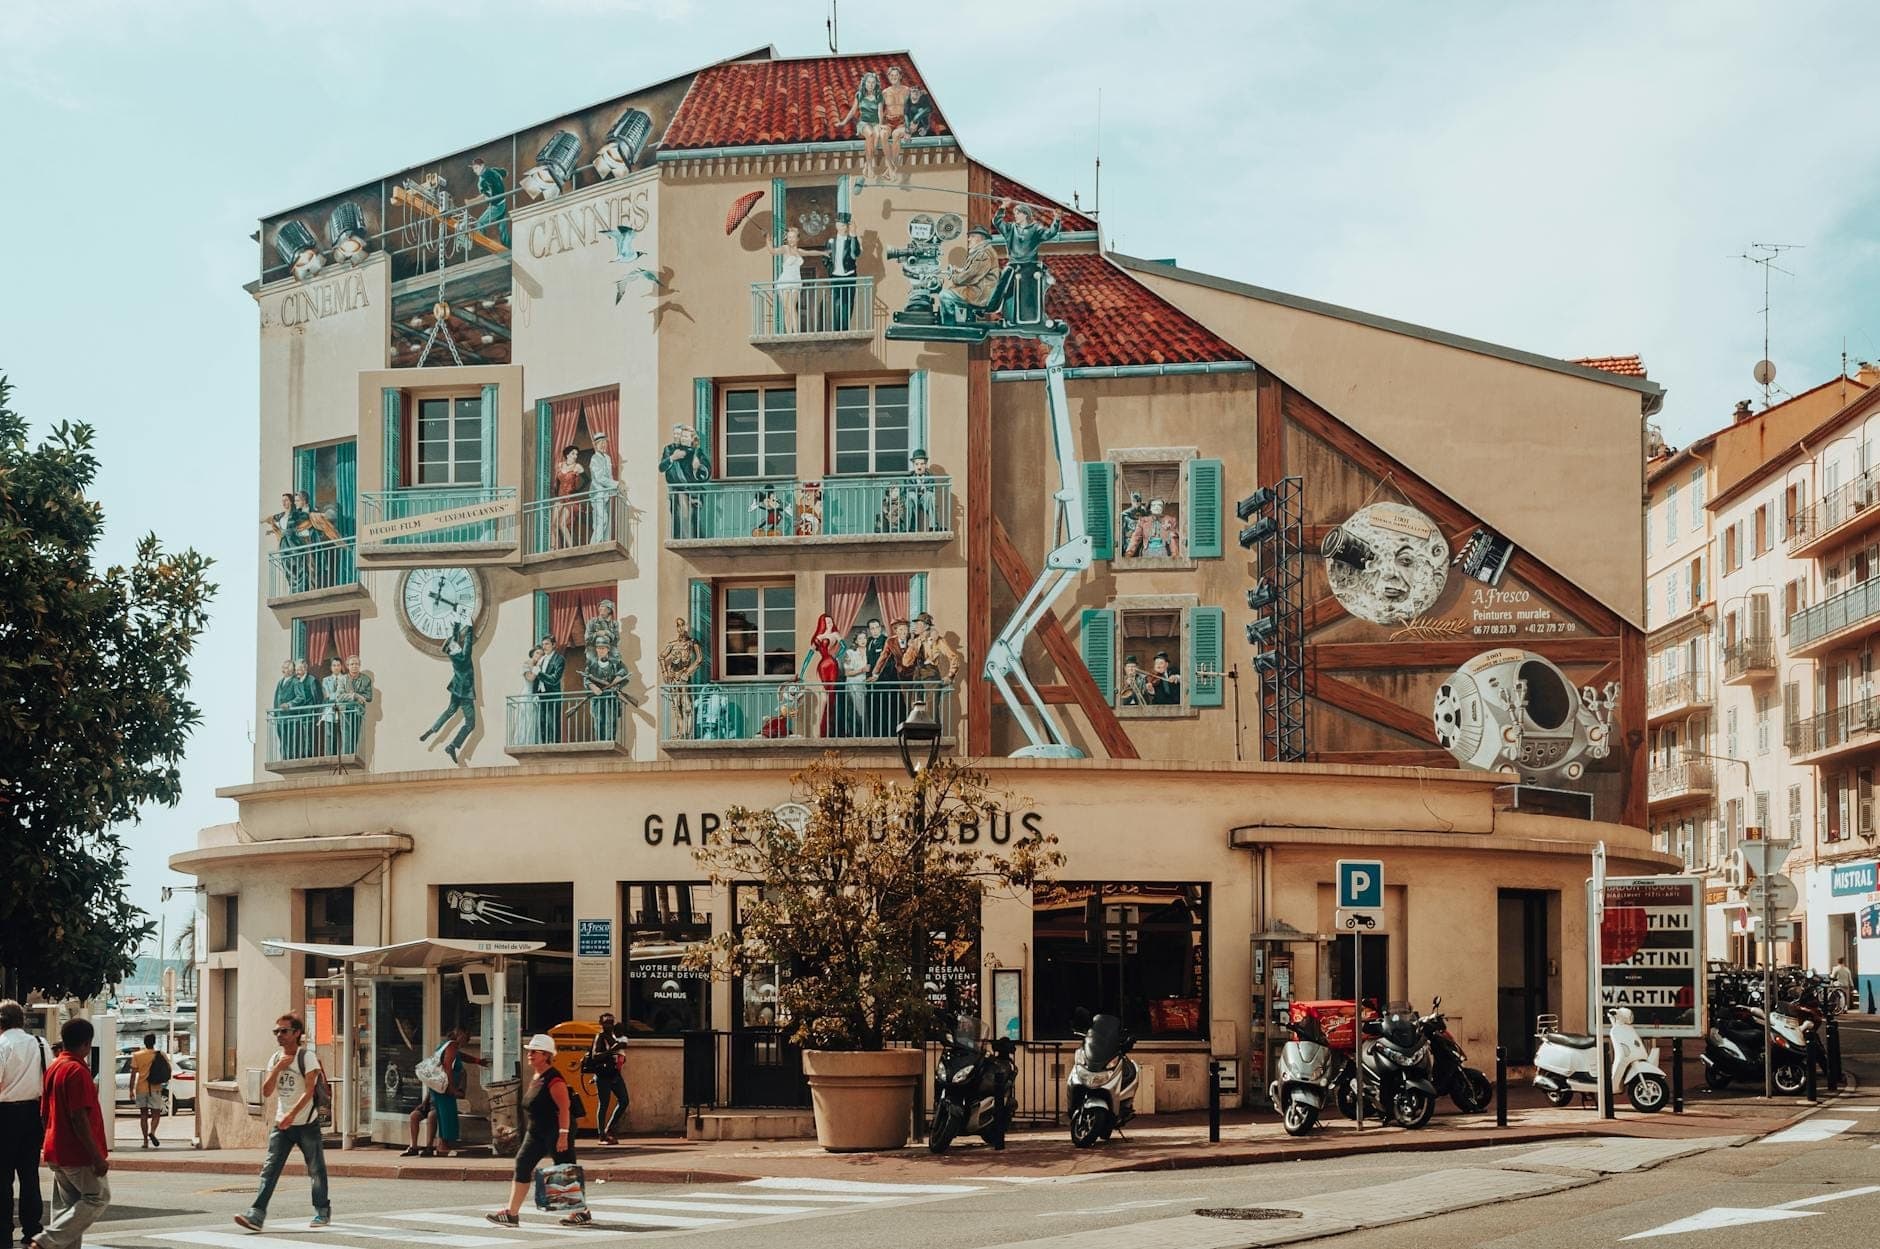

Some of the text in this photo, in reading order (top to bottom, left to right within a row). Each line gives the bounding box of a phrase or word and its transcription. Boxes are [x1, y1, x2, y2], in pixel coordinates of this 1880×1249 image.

[529, 188, 649, 258] CANNES
[400, 519, 421, 531] FILM
[1473, 608, 1551, 620] Peintures murales
[1508, 624, 1517, 633] 70
[1537, 623, 1545, 632] 22
[862, 811, 1043, 846] UOBUS
[1351, 870, 1371, 900] P
[1834, 868, 1874, 890] MISTRAL
[1616, 951, 1689, 966] RTINI
[639, 964, 669, 972] VOTRE
[630, 971, 710, 980] BUS AZUR DEVIEN
[934, 972, 977, 981] DEVIENT
